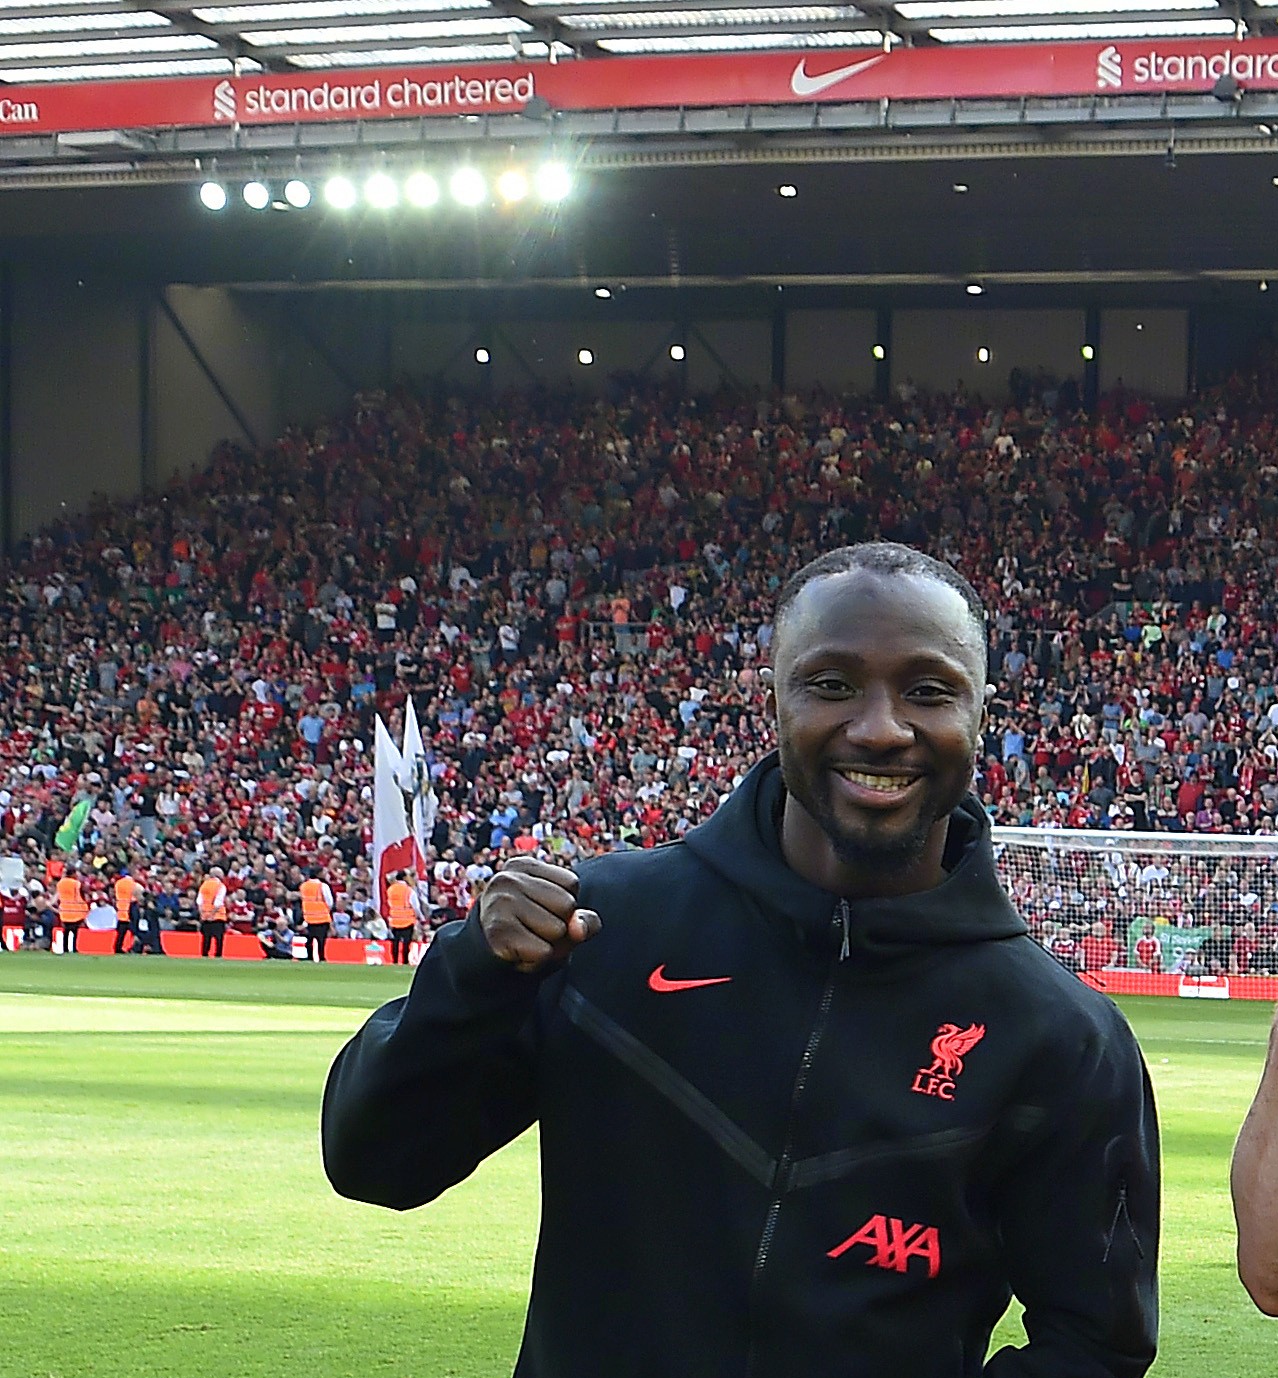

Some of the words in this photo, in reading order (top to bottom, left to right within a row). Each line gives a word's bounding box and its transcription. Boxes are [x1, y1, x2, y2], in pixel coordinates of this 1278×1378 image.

[245, 80, 380, 113] standard
[386, 72, 535, 110] chartered
[826, 1213, 942, 1279] AXA
